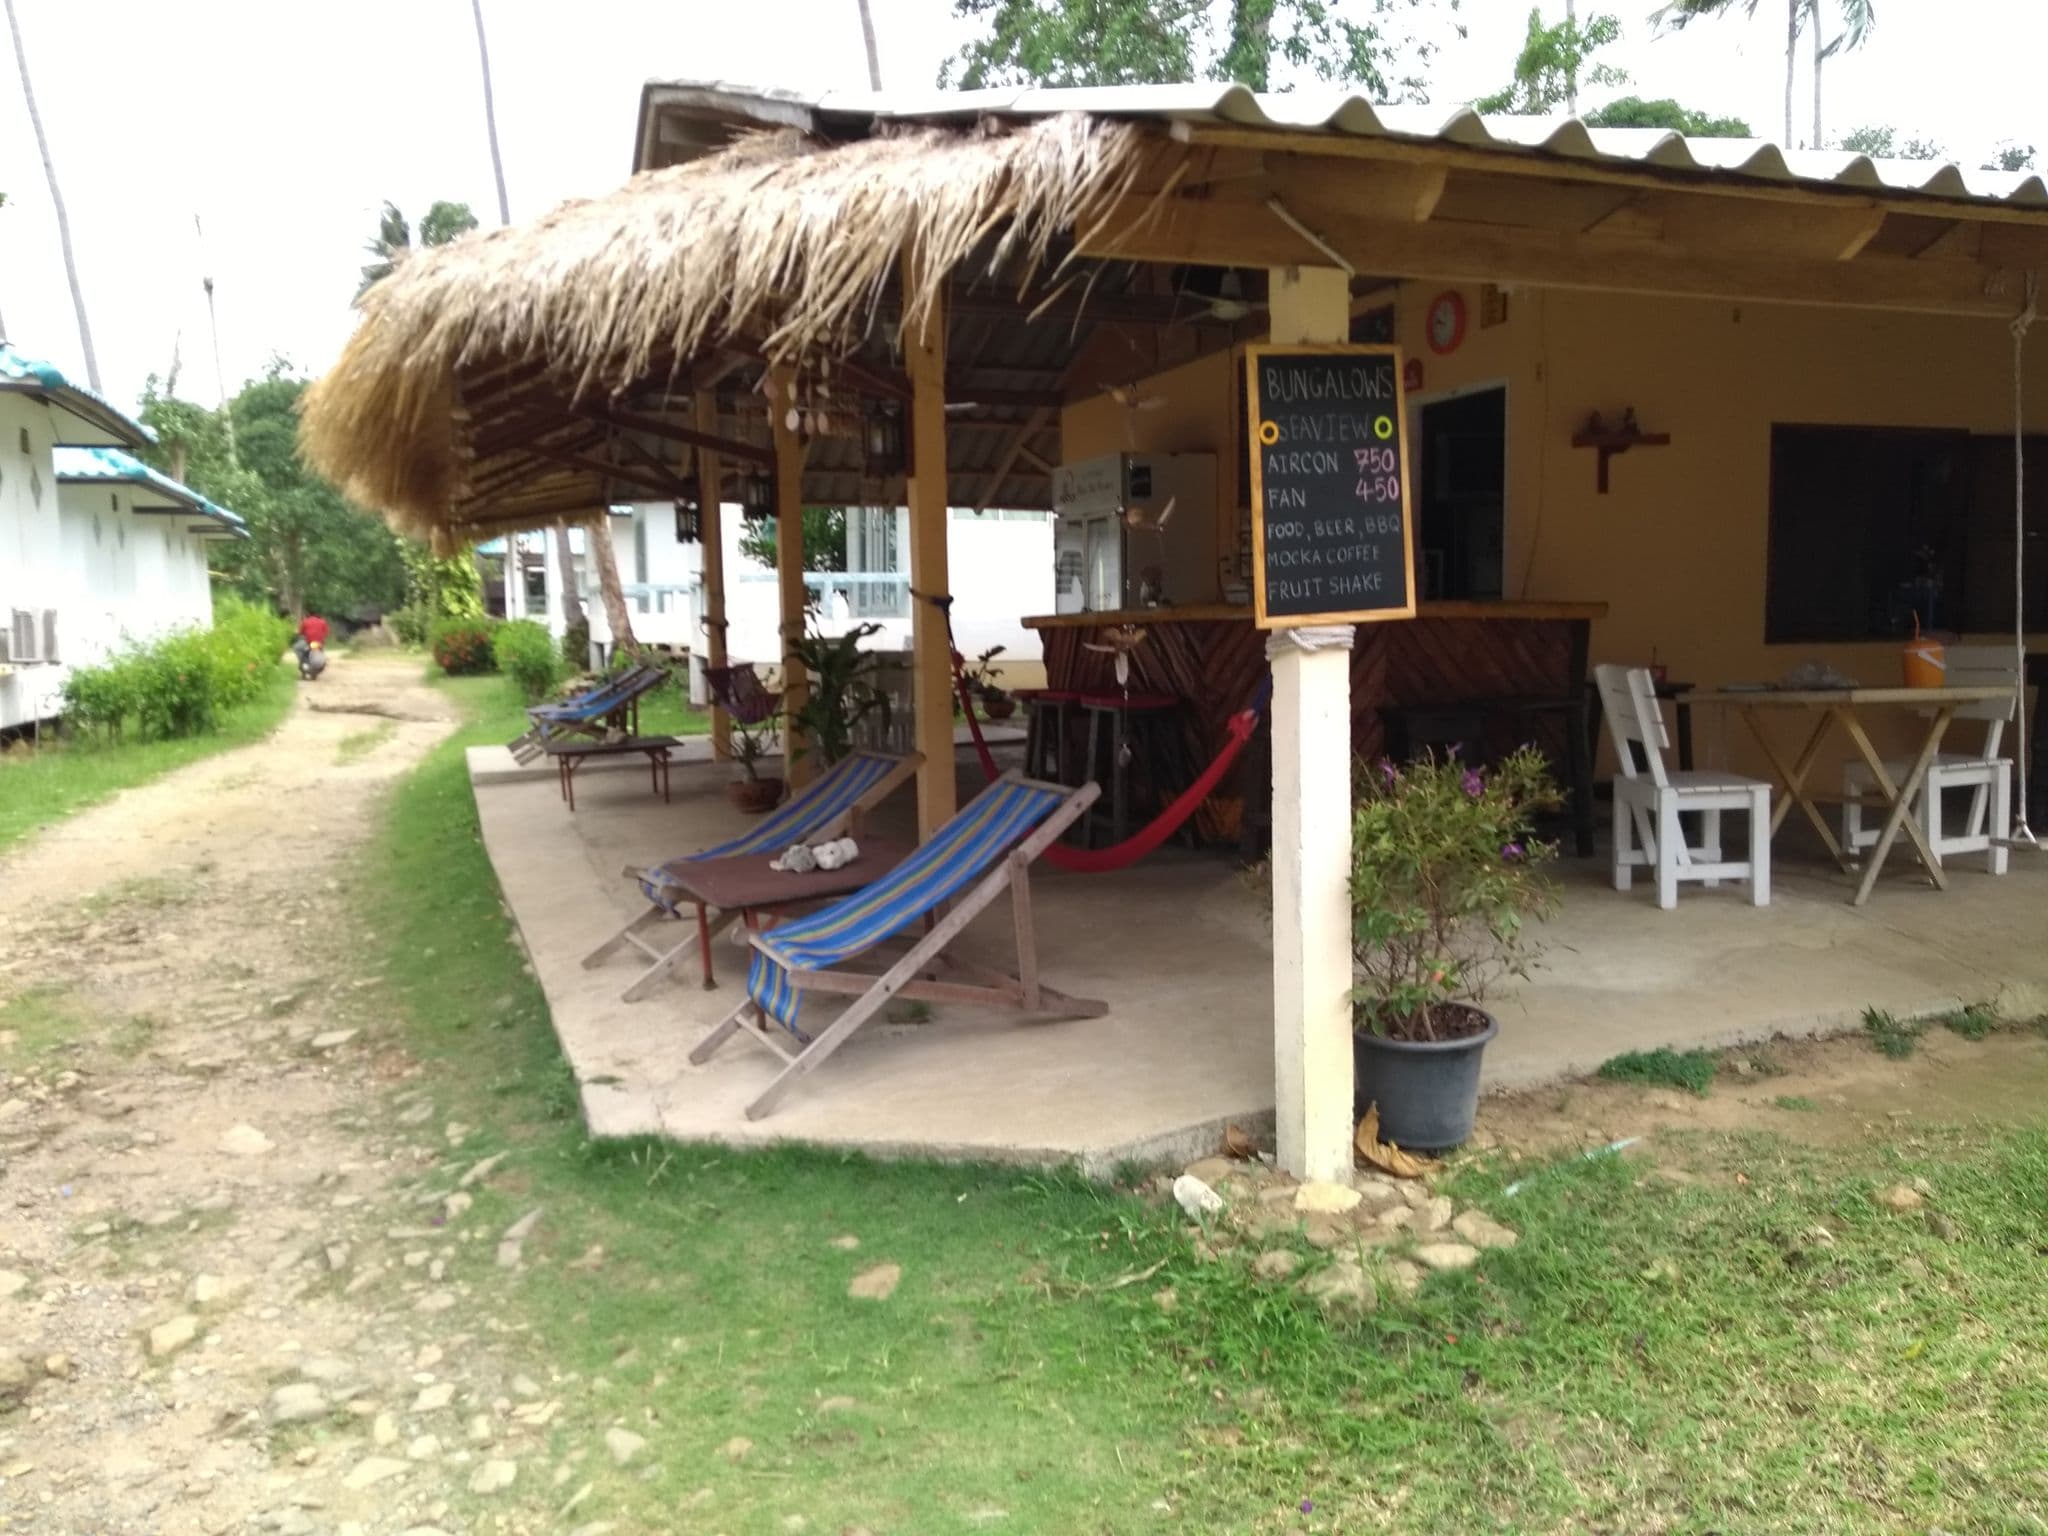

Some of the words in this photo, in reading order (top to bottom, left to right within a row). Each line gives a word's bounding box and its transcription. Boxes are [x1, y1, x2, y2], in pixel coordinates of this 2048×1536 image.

[1266, 365, 1393, 402] BUNGALOWS
[1279, 415, 1369, 442] SEAVIEW
[1267, 451, 1339, 474] AIRCON
[1353, 447, 1395, 474] 750
[1267, 487, 1307, 509] FAN
[1365, 514, 1401, 535] BBQ
[1267, 547, 1321, 569] MOCKA
[1326, 543, 1381, 564] COFFEE
[1267, 577, 1322, 601] FRUIT
[1329, 572, 1383, 596] SHAKE
